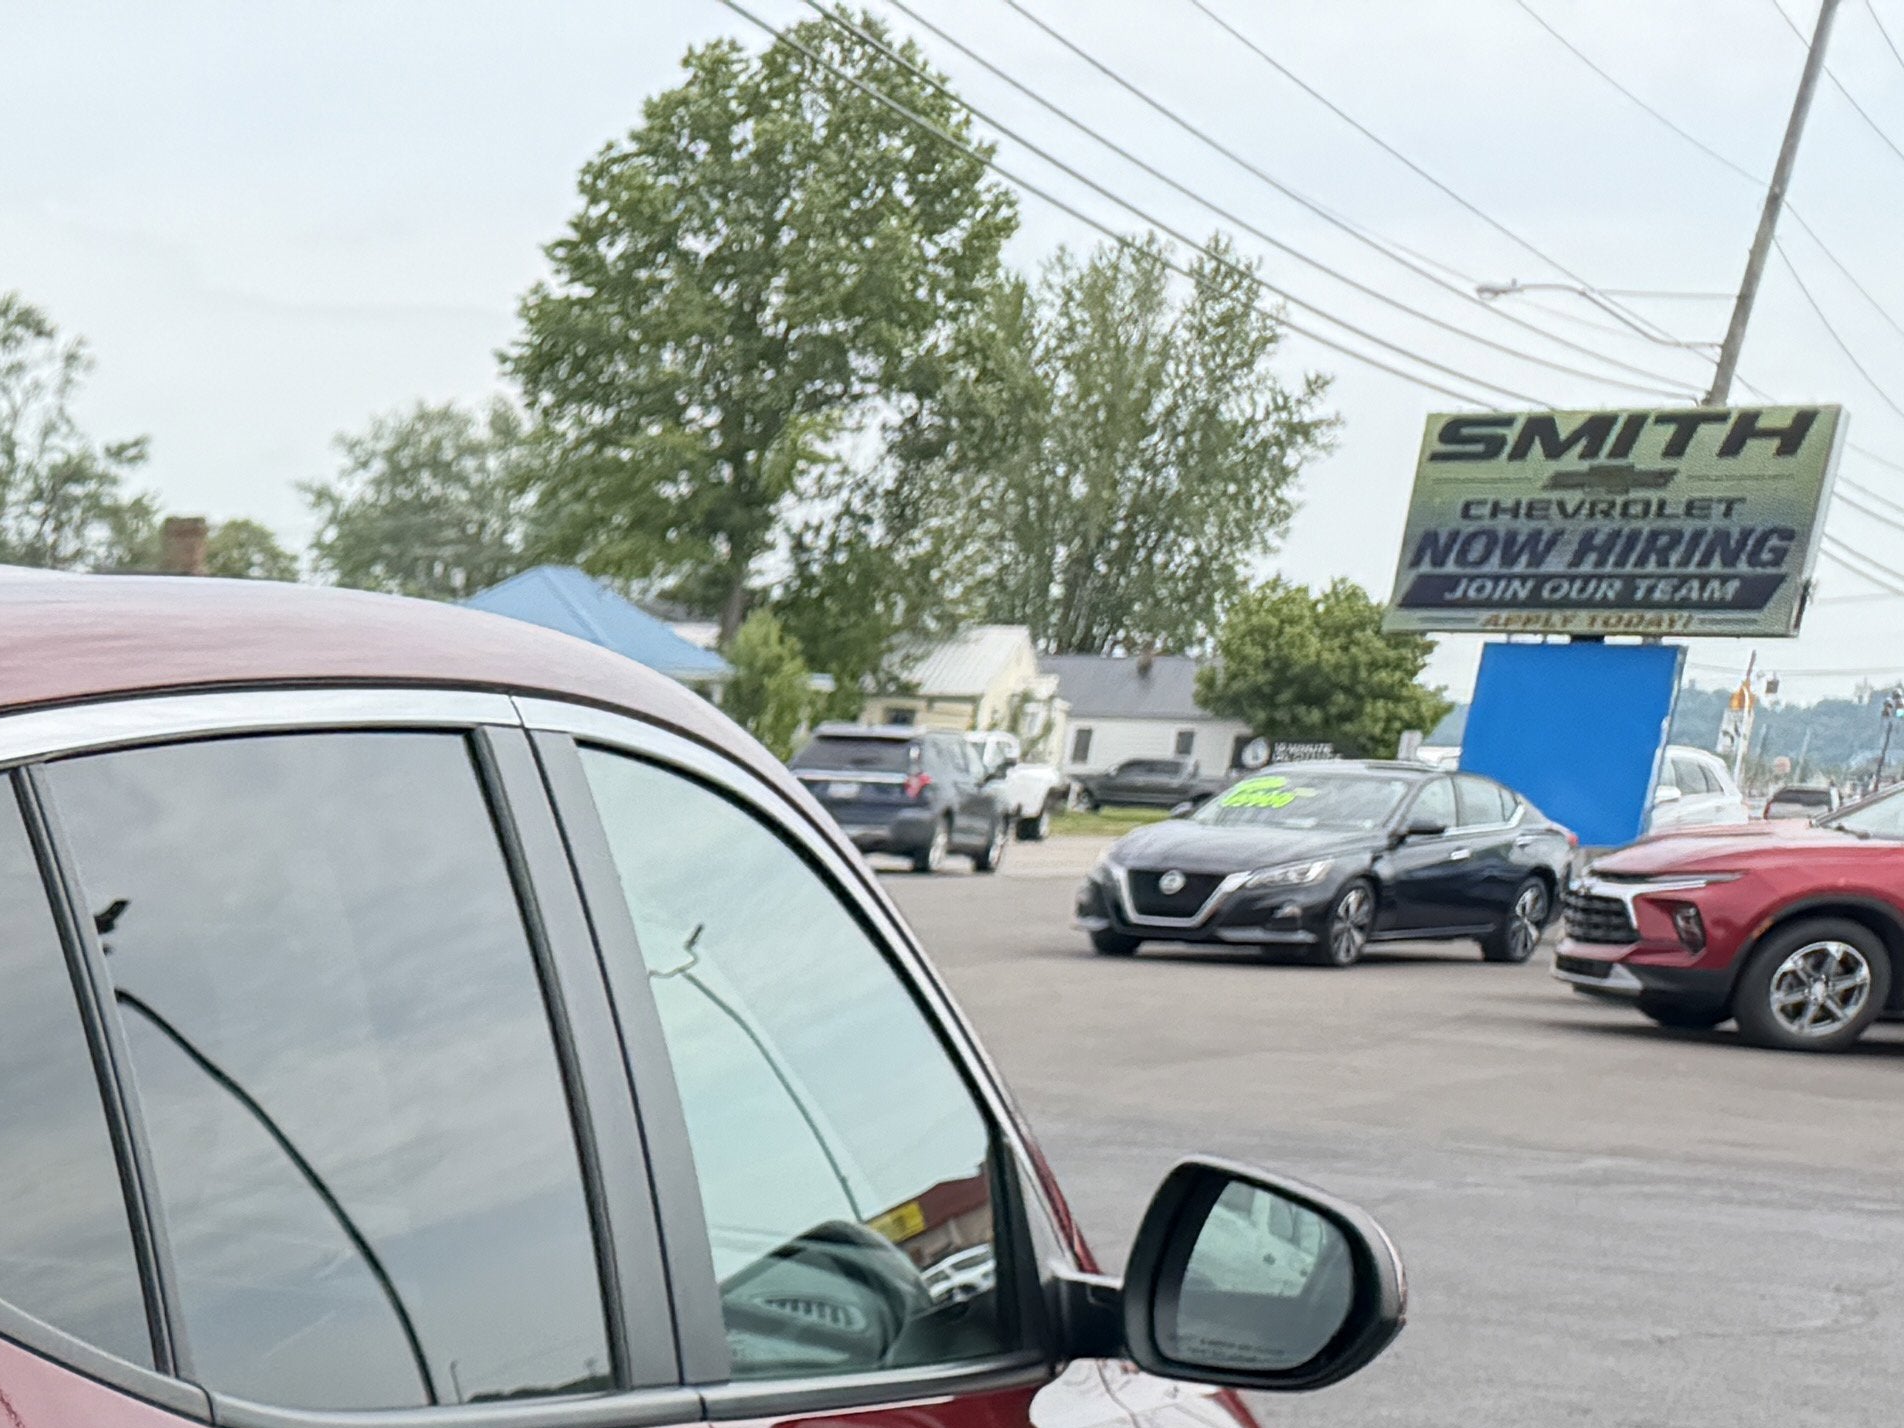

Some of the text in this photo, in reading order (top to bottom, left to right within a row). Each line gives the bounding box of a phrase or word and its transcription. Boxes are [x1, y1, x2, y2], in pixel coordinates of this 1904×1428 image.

[1428, 409, 1821, 463] SMITH
[1460, 496, 1748, 521] CHEVROLET
[1407, 526, 1796, 570] NOW HIRING
[1444, 577, 1741, 601] JOIN OUR TEAM
[1481, 613, 1693, 629] APPLY TODAY!
